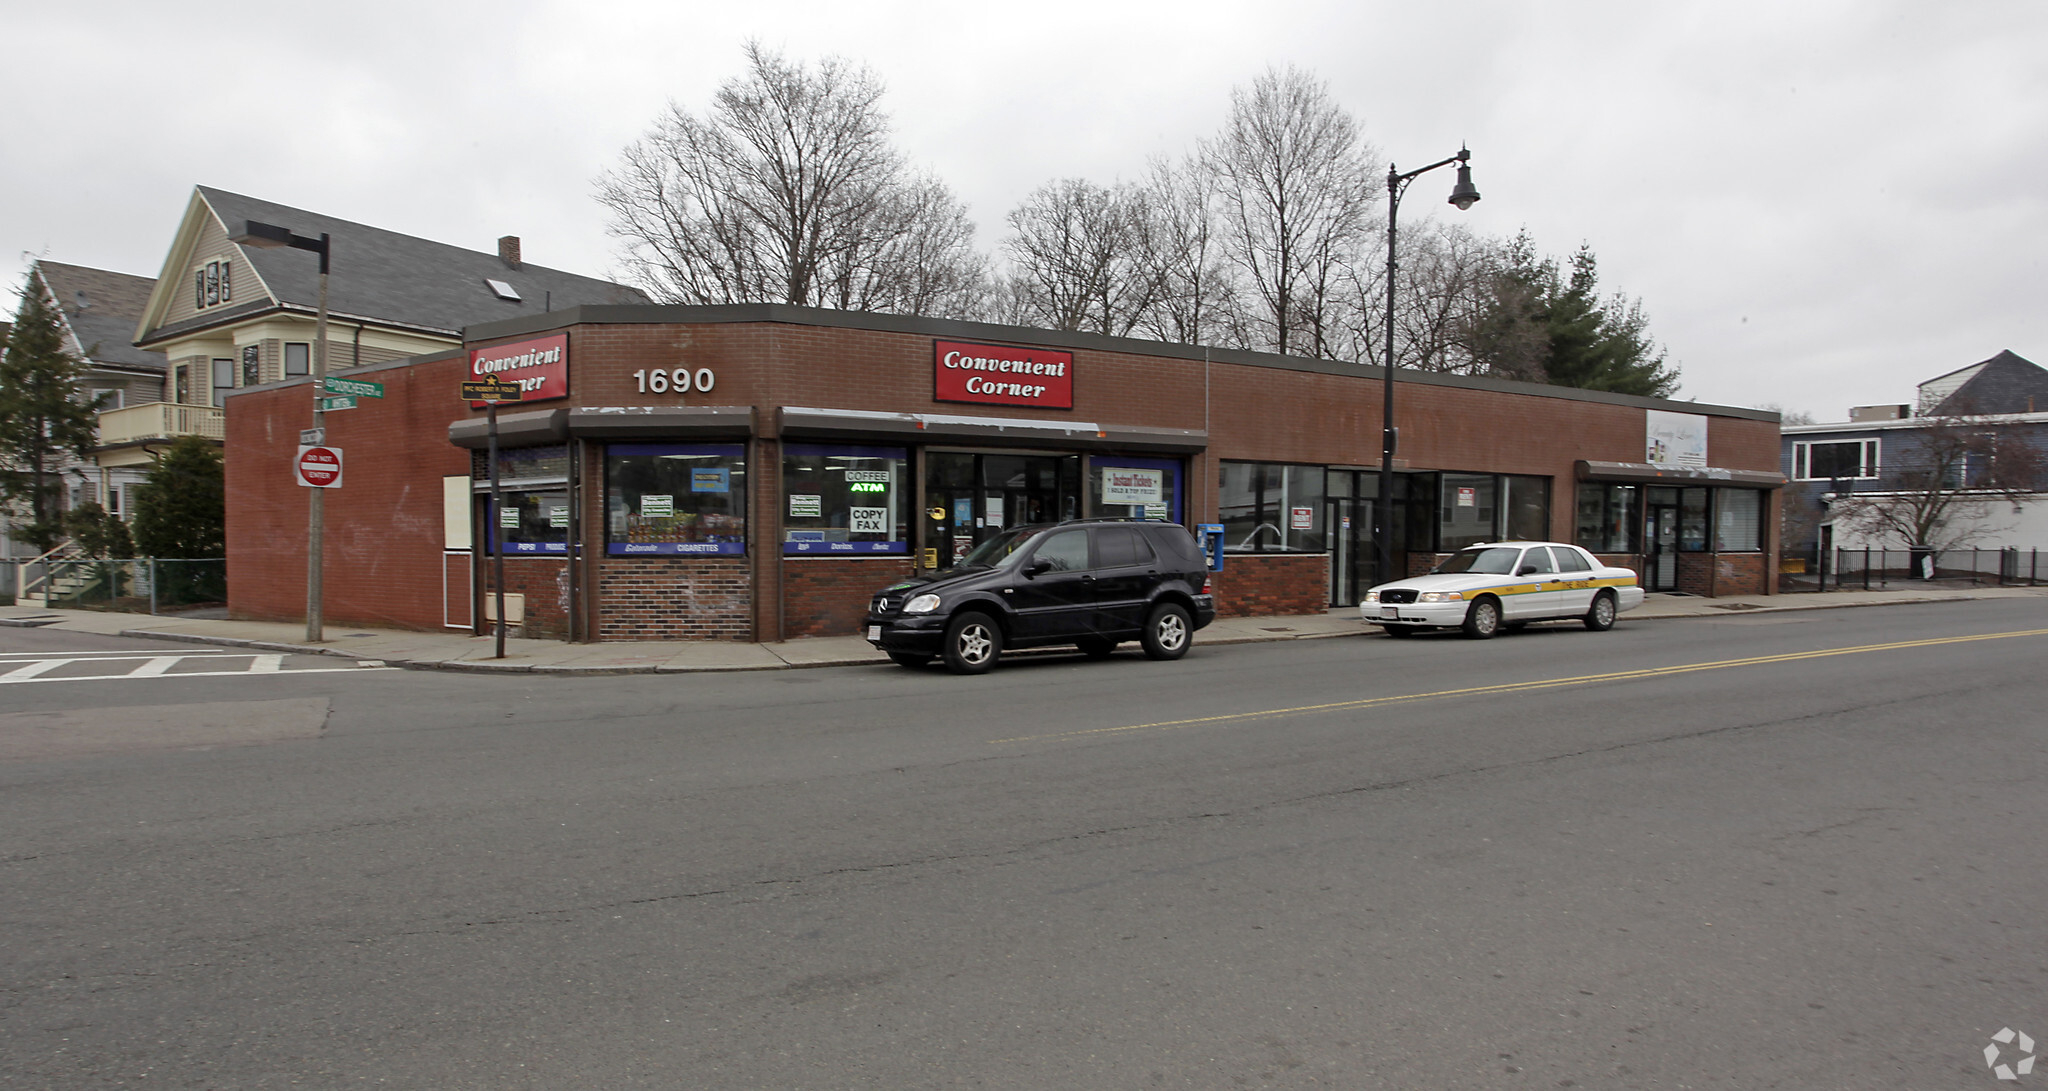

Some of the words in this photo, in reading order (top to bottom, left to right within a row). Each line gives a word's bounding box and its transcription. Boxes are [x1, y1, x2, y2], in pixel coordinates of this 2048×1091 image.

[473, 346, 561, 375] Convenient
[943, 351, 1066, 377] Convenient
[633, 368, 715, 393] 1690
[334, 380, 375, 396] DORCHESTER
[965, 376, 1046, 398] Corner
[309, 471, 330, 479] ENTER
[847, 471, 888, 481] COFFEE
[1113, 473, 1132, 487] Instant
[1133, 474, 1153, 488] Tickets
[850, 482, 885, 492] ATM
[852, 509, 884, 520] COPY
[1294, 514, 1310, 522] RENT
[856, 520, 880, 530] FAX
[517, 543, 537, 551] PEPSI
[624, 544, 658, 552] Gatorade
[677, 544, 719, 552] CIGARETTES
